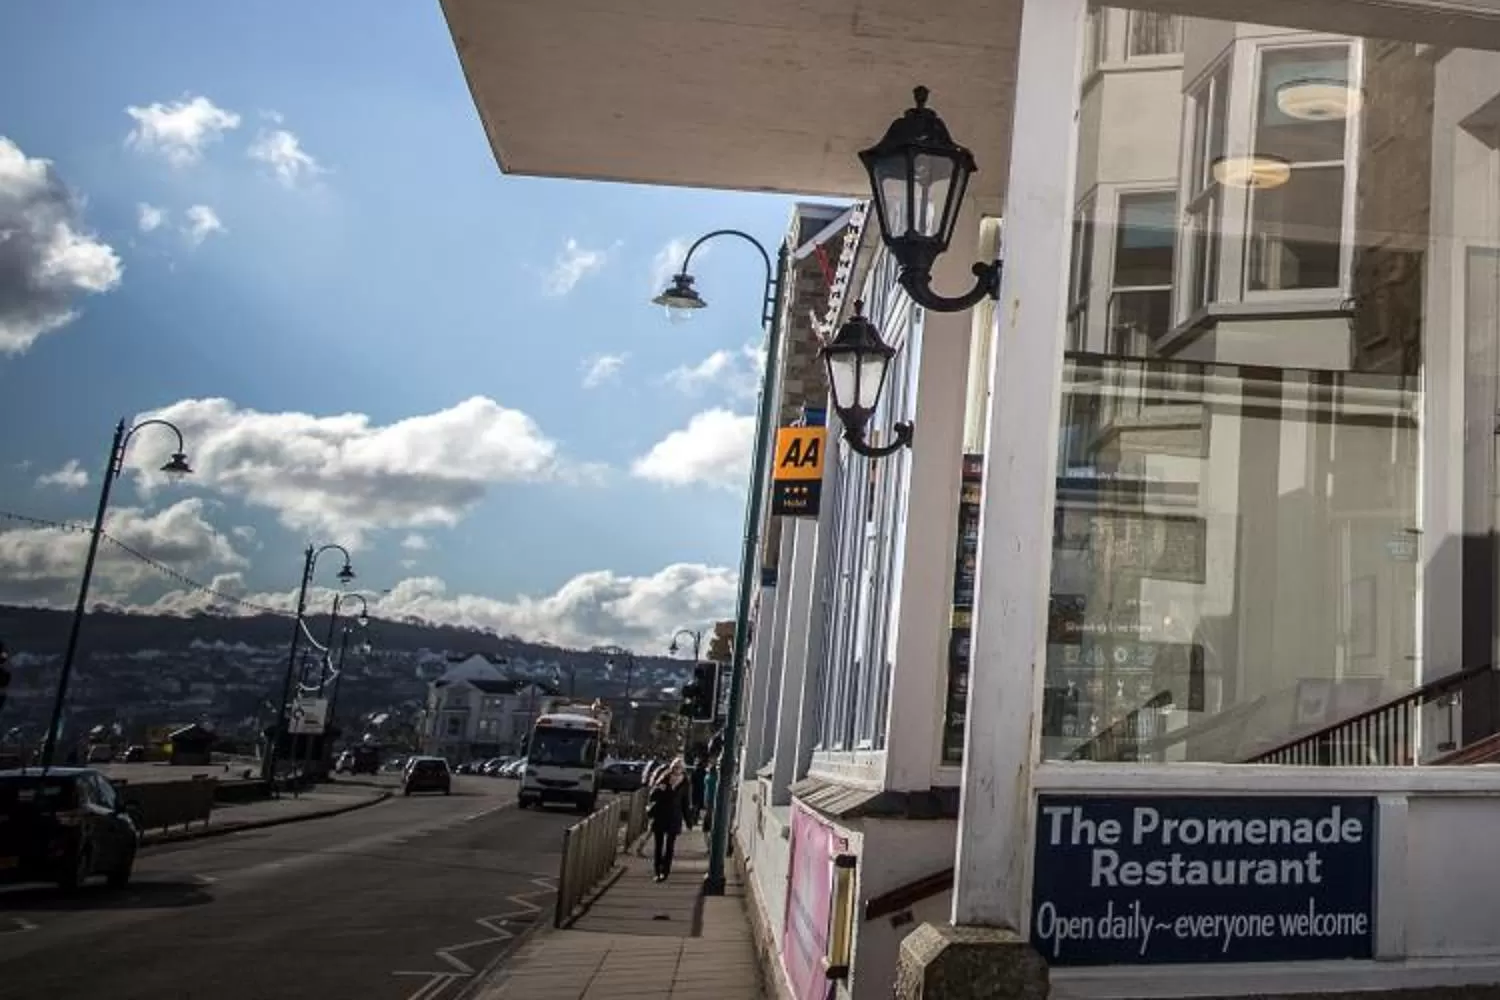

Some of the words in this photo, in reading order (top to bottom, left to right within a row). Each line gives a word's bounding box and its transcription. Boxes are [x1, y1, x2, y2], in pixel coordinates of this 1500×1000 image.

[780, 437, 820, 468] AA
[1043, 806, 1122, 845] The
[1131, 805, 1363, 845] Promenade
[1091, 849, 1323, 888] Restaurant
[1037, 901, 1093, 958] Open
[1279, 897, 1368, 936] welcome
